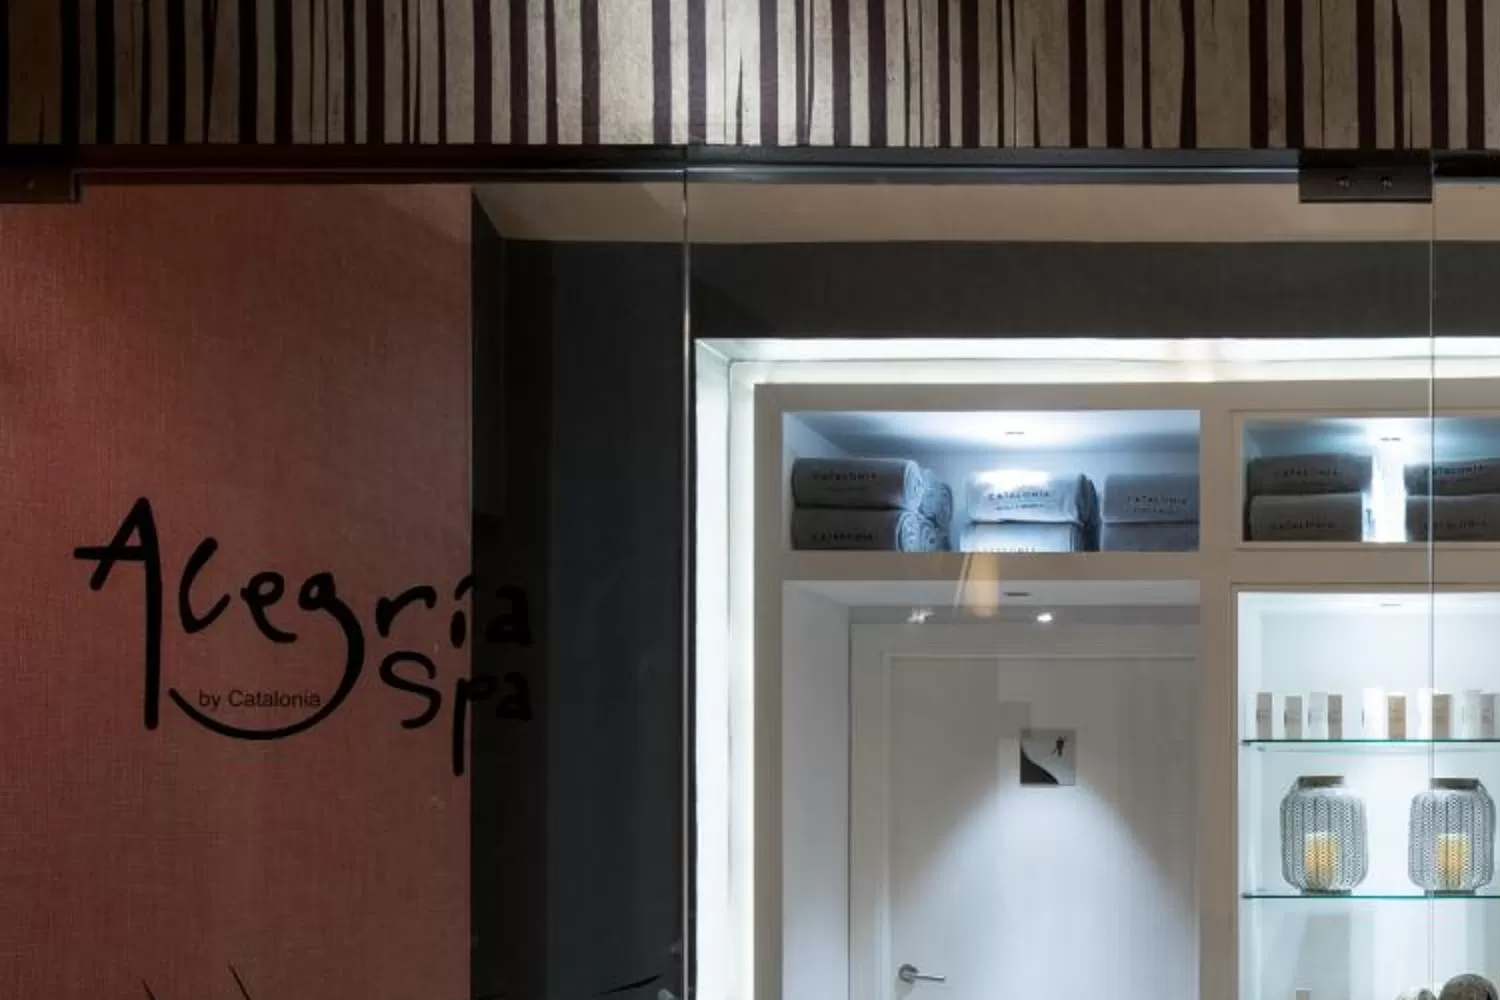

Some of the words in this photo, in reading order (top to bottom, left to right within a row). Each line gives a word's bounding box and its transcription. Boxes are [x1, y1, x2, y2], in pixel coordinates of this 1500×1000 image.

[198, 690, 221, 711] by
[228, 689, 321, 708] Catalonia
[379, 651, 532, 776] Spa
